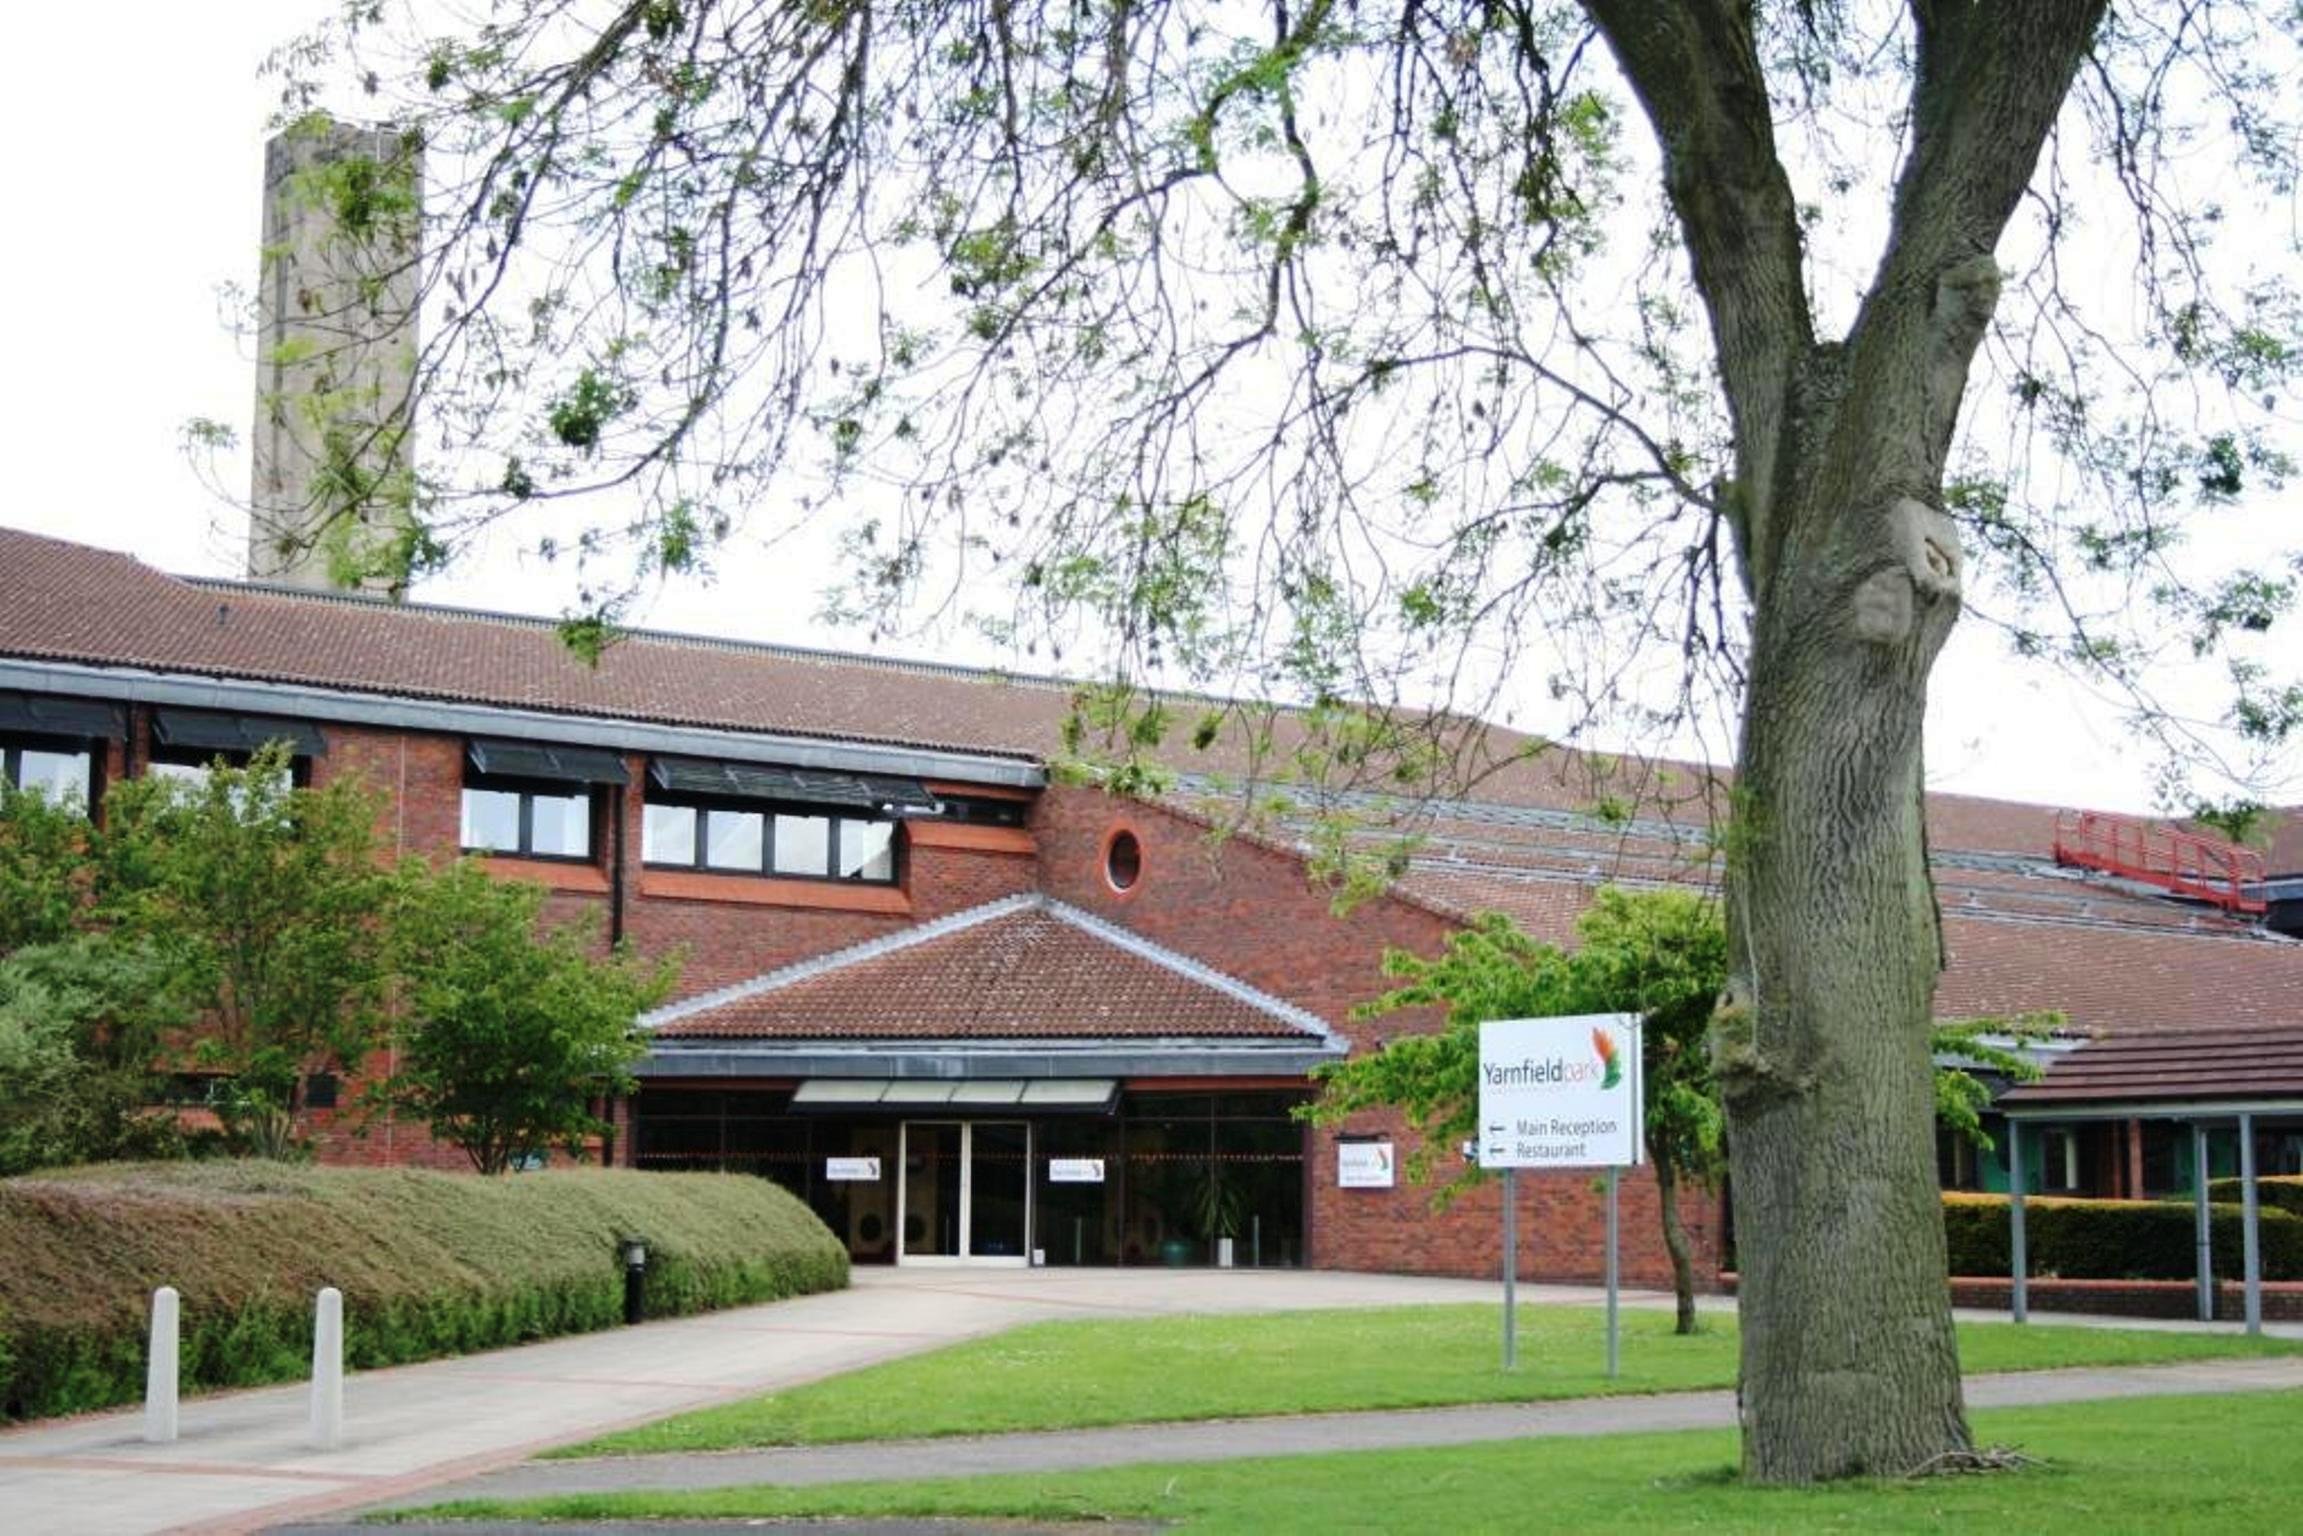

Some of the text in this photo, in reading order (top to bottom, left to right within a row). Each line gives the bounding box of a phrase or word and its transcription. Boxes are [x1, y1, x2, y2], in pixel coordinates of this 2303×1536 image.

[1517, 1118, 1617, 1139] Main Reception
[1517, 1141, 1587, 1158] Restaurant
